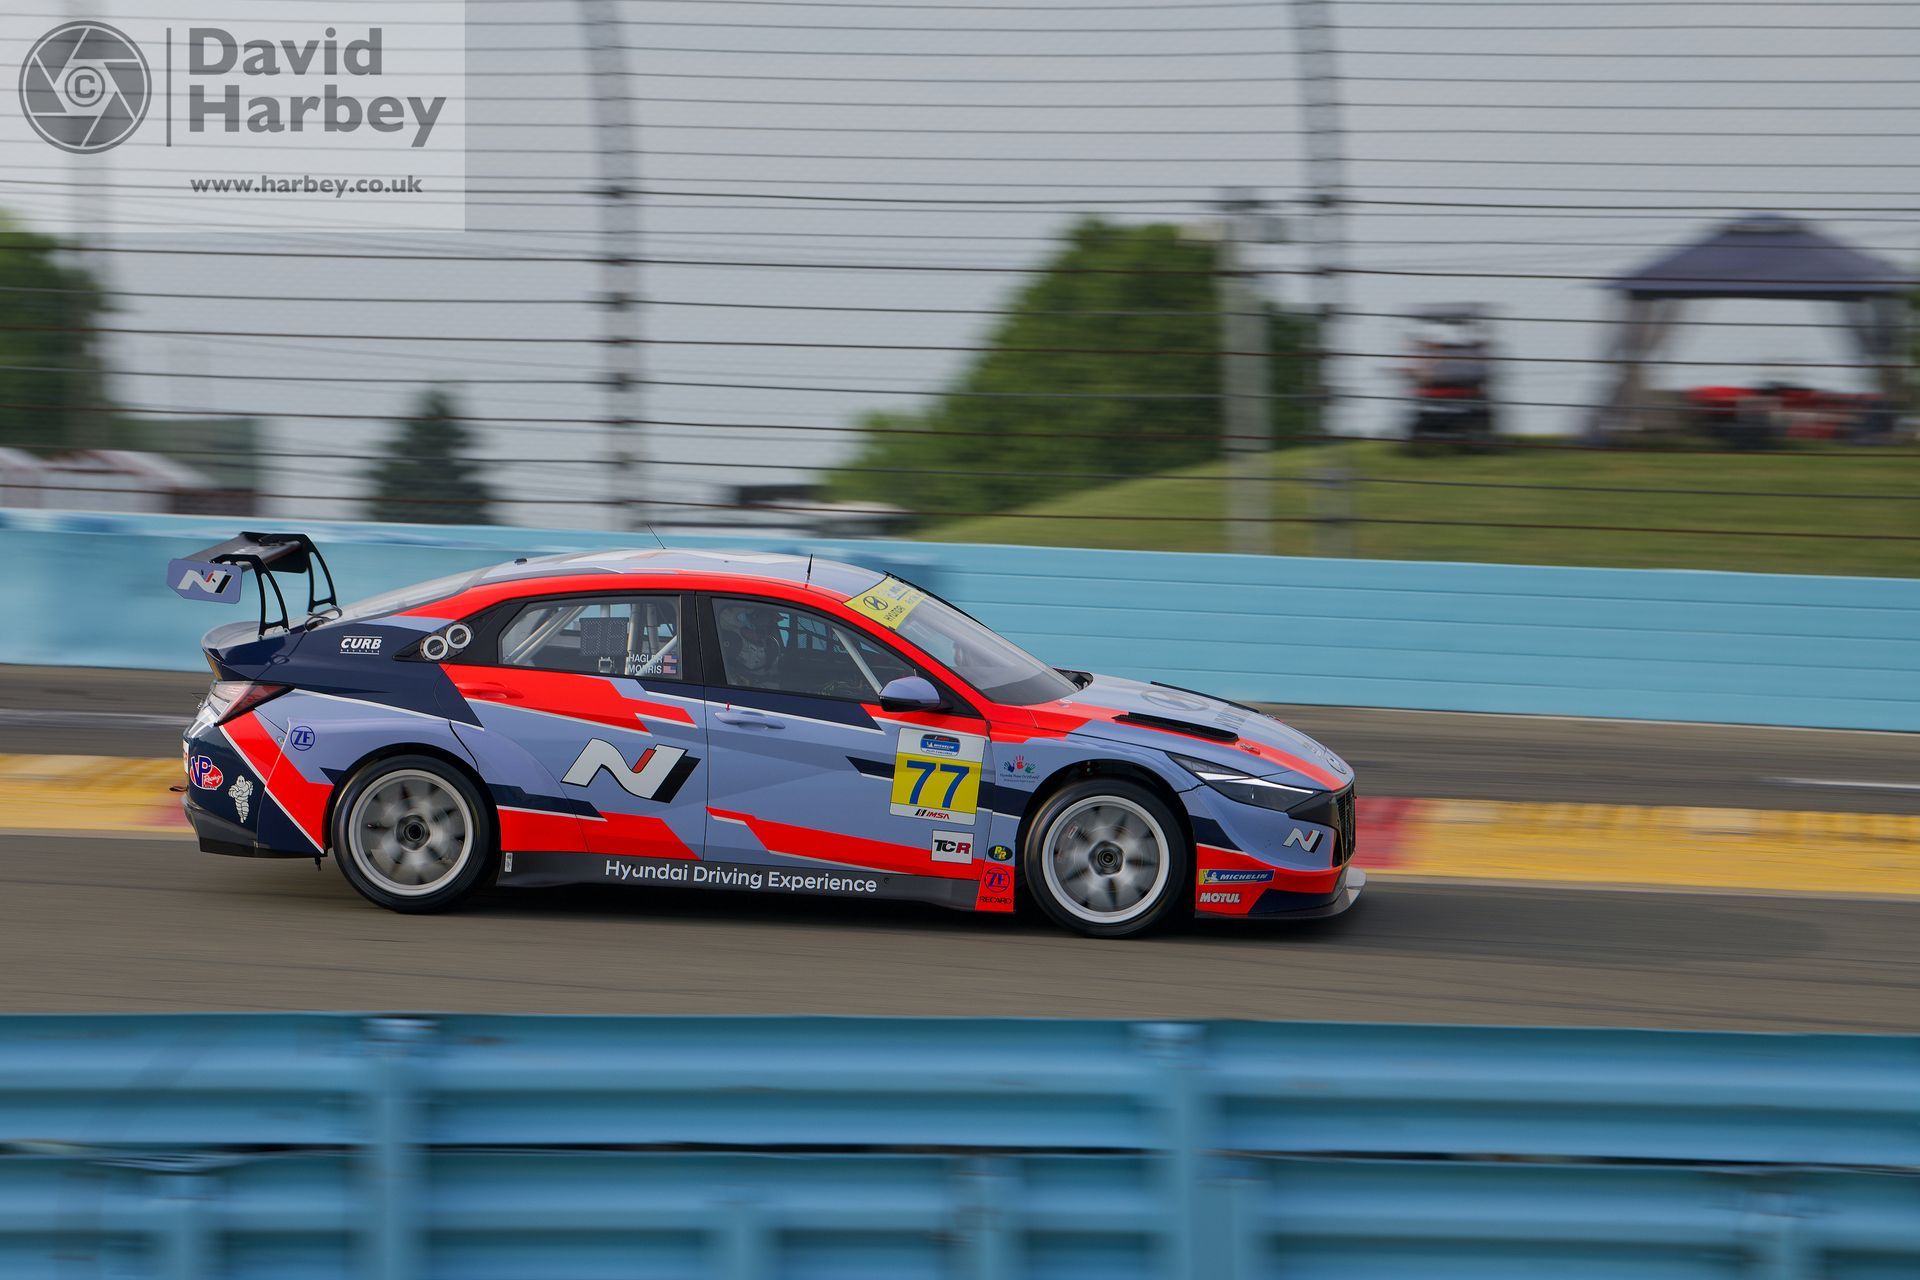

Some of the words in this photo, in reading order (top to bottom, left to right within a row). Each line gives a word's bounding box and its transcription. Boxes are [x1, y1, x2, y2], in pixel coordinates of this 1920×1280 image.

[340, 638, 382, 650] CURB
[293, 731, 313, 747] ZF
[191, 755, 212, 787] VP
[906, 760, 970, 808] 77
[926, 811, 950, 819] IMSA
[934, 839, 971, 854] TCR
[605, 859, 689, 880] Hyundai
[693, 866, 763, 889] Driving
[767, 870, 878, 893] Experience
[1200, 892, 1240, 903] MOTUL
